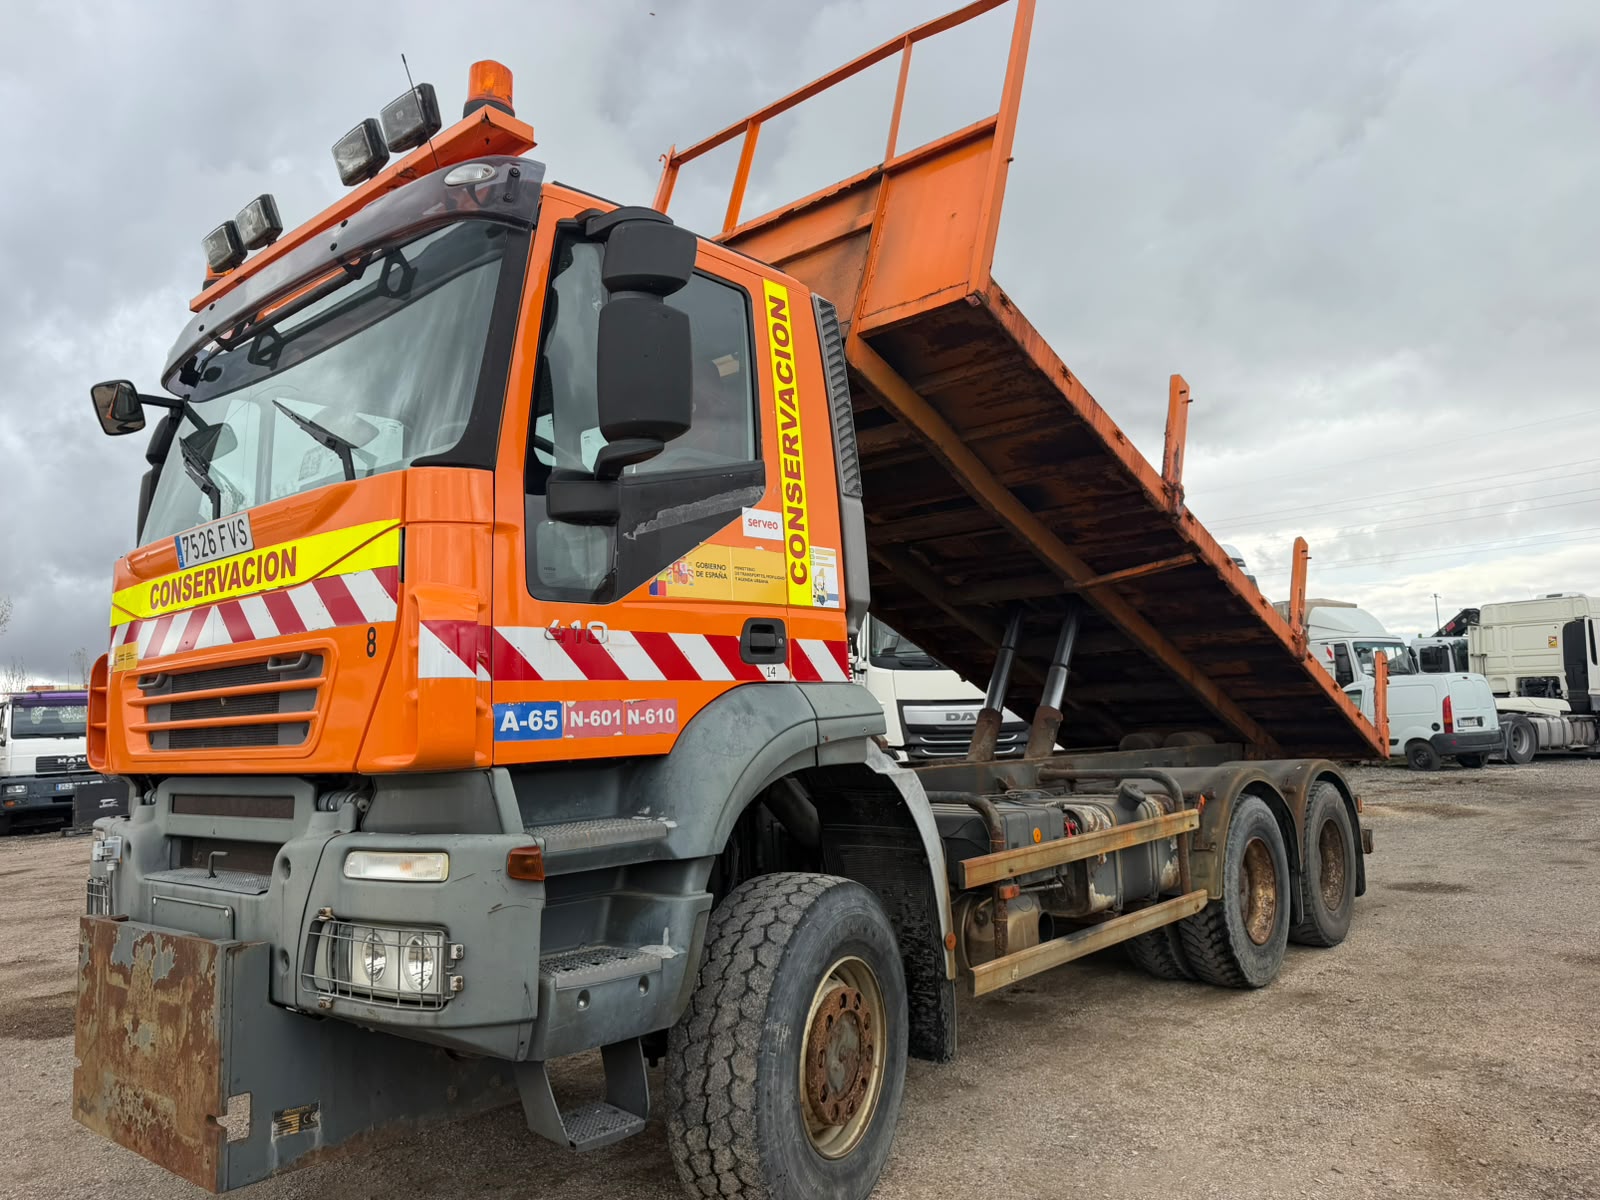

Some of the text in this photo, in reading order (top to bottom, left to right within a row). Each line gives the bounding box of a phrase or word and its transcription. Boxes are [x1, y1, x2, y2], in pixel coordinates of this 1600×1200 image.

[768, 294, 807, 586] CONSERVACION
[748, 517, 778, 530] serveo
[182, 519, 247, 563] 7526 FVS
[696, 562, 726, 571] GOBIERNO
[696, 570, 728, 580] DE ESPAÑA
[150, 546, 296, 610] CONSERVACION
[367, 626, 377, 658] 8
[544, 619, 609, 645] 410
[766, 666, 776, 678] 14
[499, 709, 558, 732] A-65
[570, 708, 675, 728] N-601 N-610
[945, 712, 977, 721] DA
